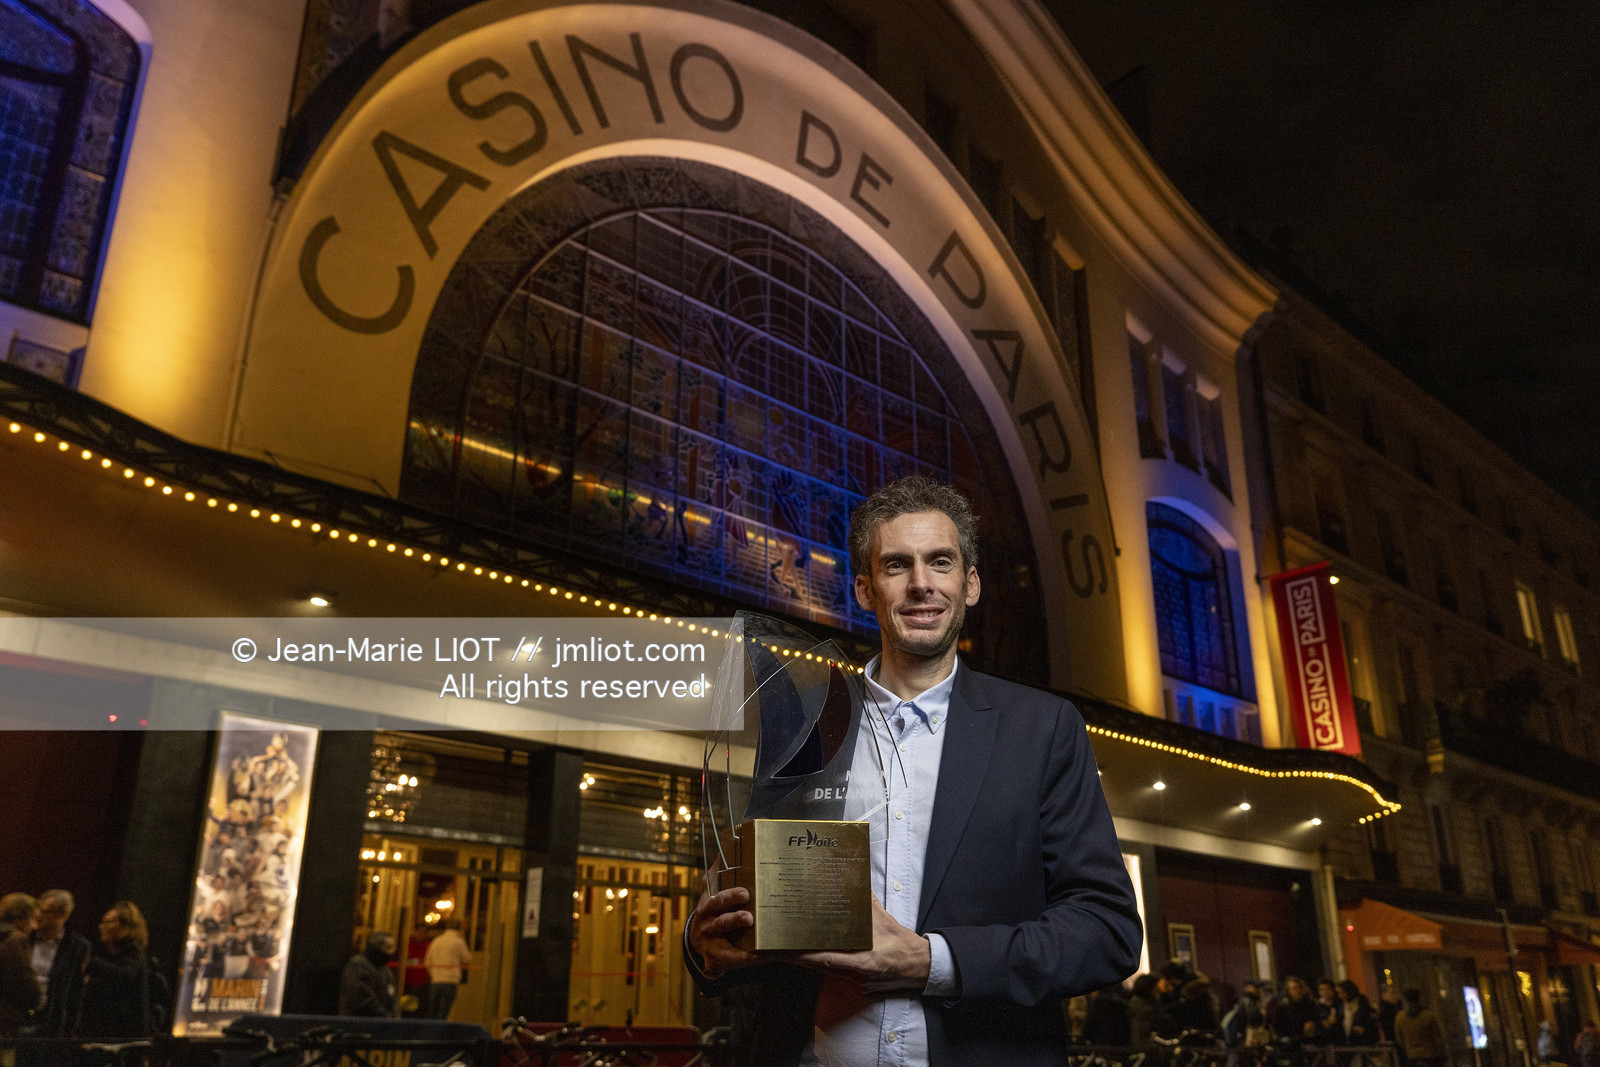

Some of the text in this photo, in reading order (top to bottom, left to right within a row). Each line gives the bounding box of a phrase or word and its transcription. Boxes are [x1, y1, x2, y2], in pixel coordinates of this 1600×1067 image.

[299, 32, 1108, 600] CASINO DE PARIS
[1293, 585, 1322, 646] PARIS
[1305, 659, 1335, 744] CASINO
[814, 788, 832, 800] DE
